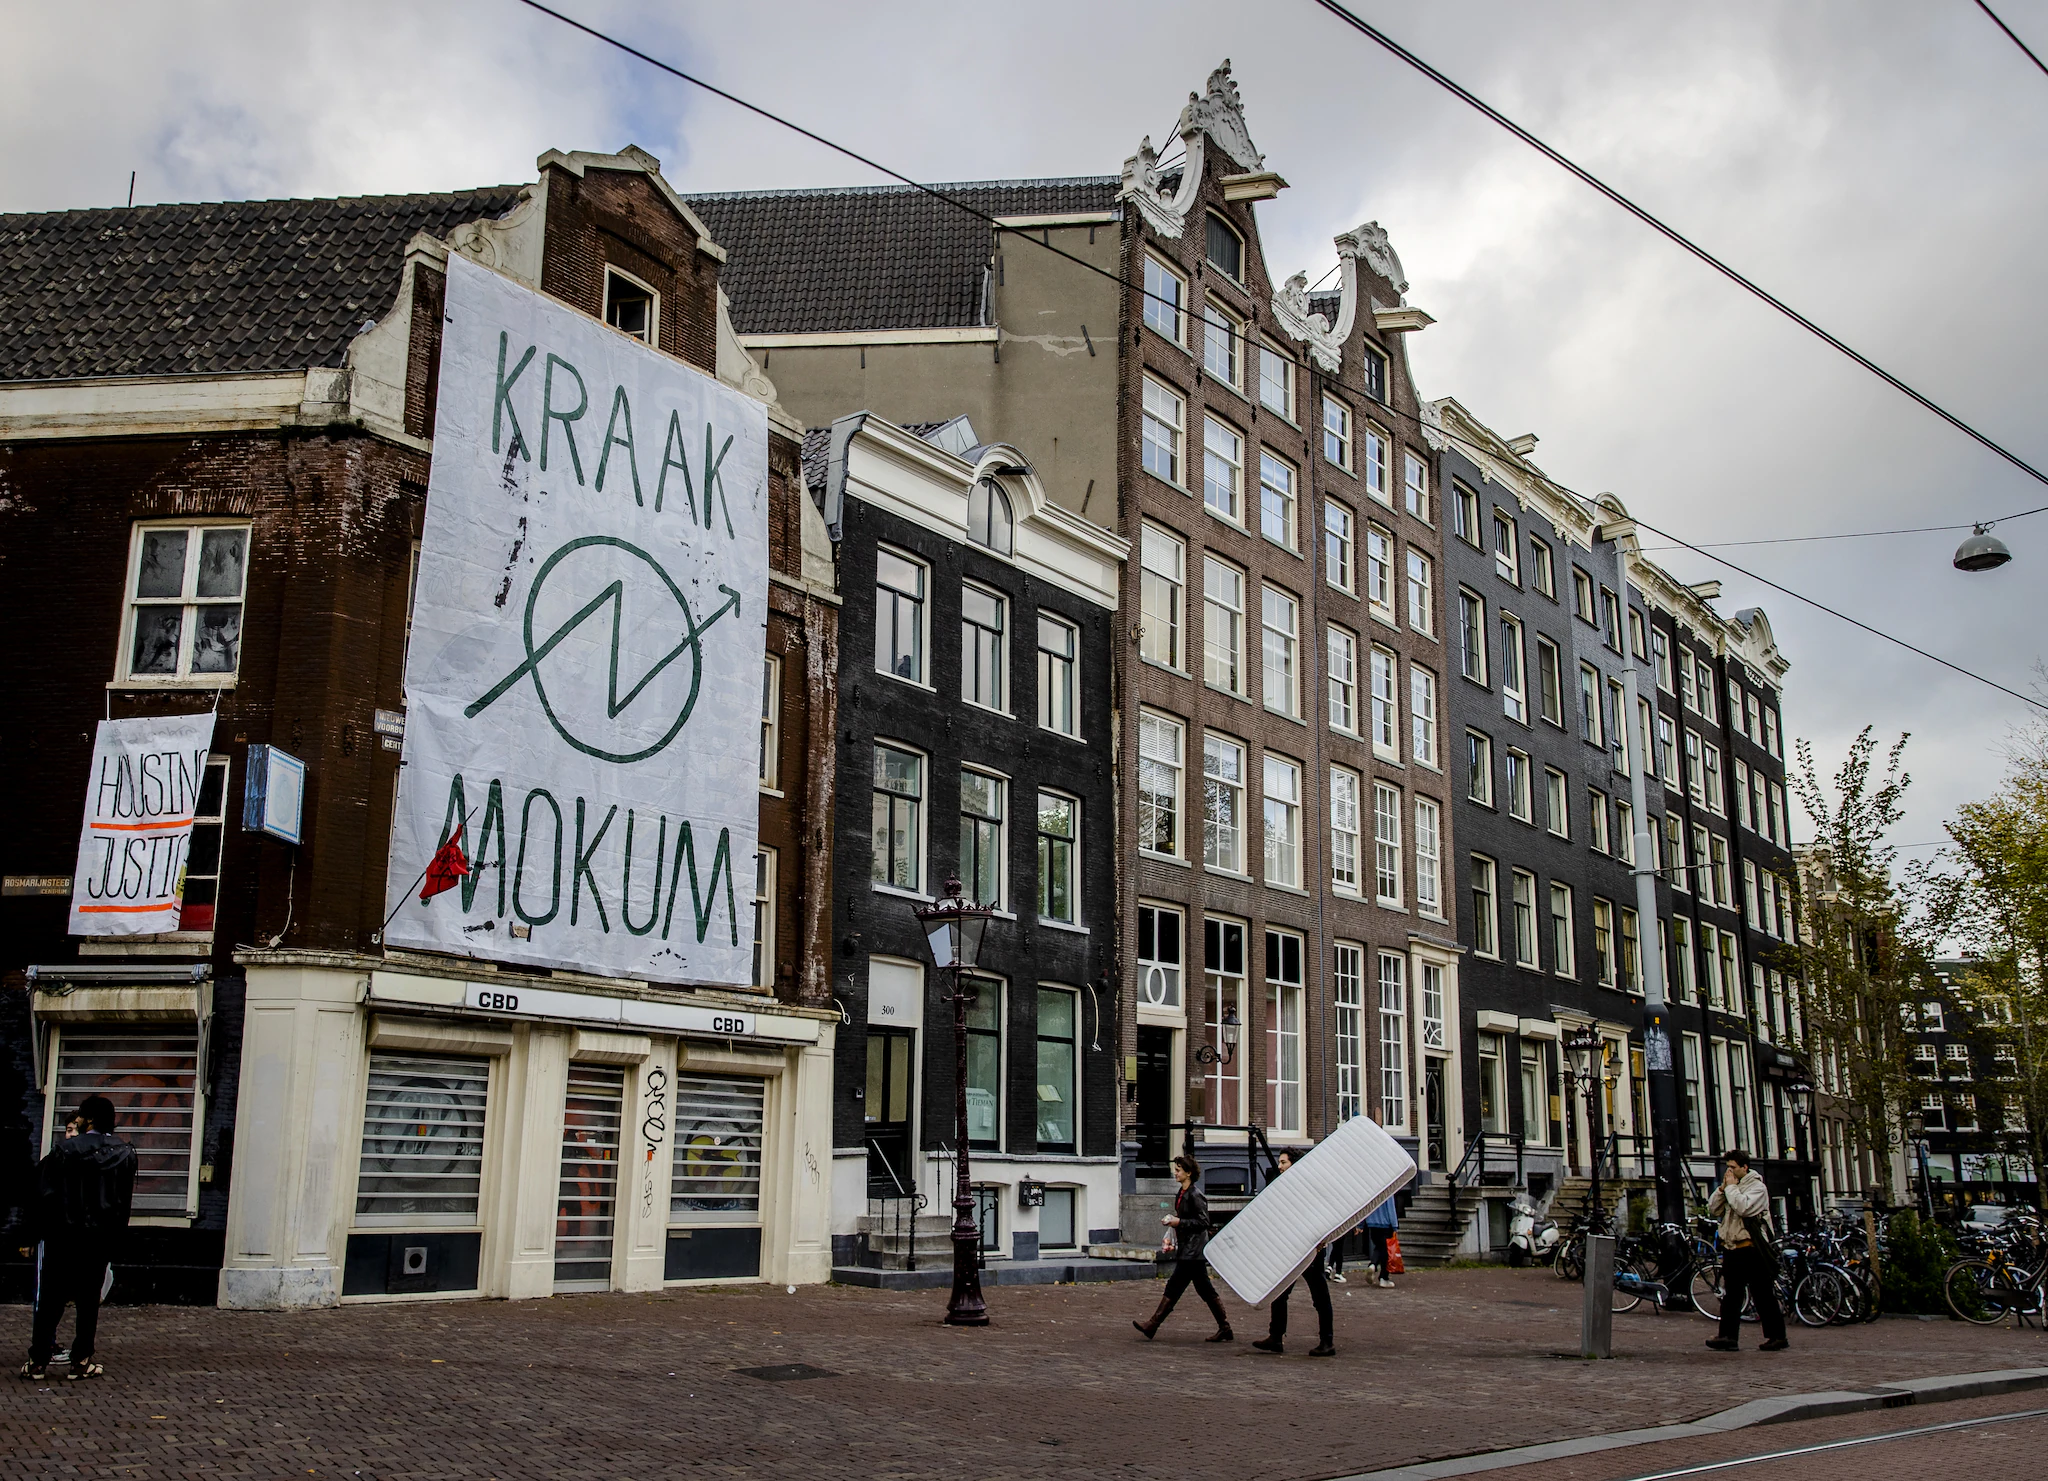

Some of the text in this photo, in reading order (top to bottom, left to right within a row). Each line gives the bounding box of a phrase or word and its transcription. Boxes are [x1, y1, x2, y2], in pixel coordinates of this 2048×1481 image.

[492, 330, 735, 540] KRAAK
[421, 772, 740, 948] MOKUM
[4, 878, 71, 887] ROSMARIJNSTEEG
[478, 991, 519, 1011] CBD
[881, 1004, 895, 1016] 300
[712, 1016, 744, 1034] CBD
